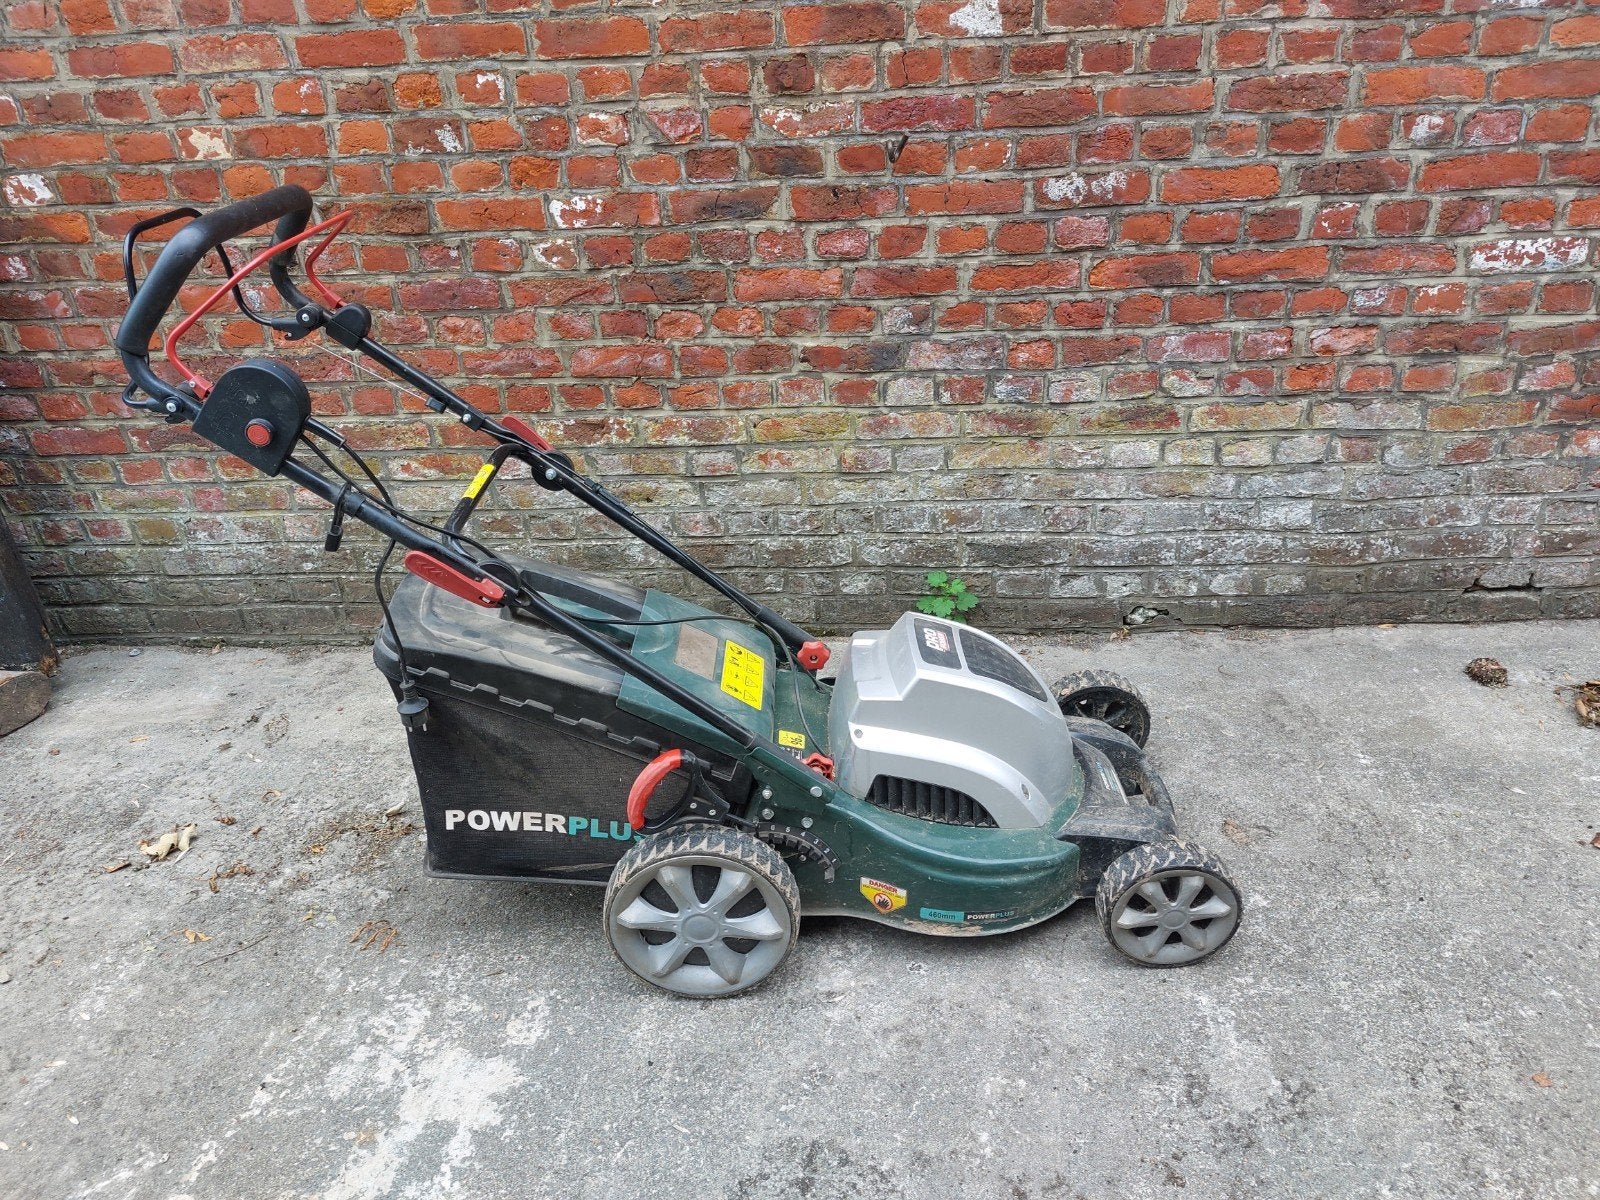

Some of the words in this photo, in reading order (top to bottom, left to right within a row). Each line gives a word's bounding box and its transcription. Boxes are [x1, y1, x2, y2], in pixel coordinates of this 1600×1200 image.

[869, 880, 898, 894] DANGER
[928, 911, 956, 920] 460mm
[967, 911, 1014, 920] POWERPLUS
